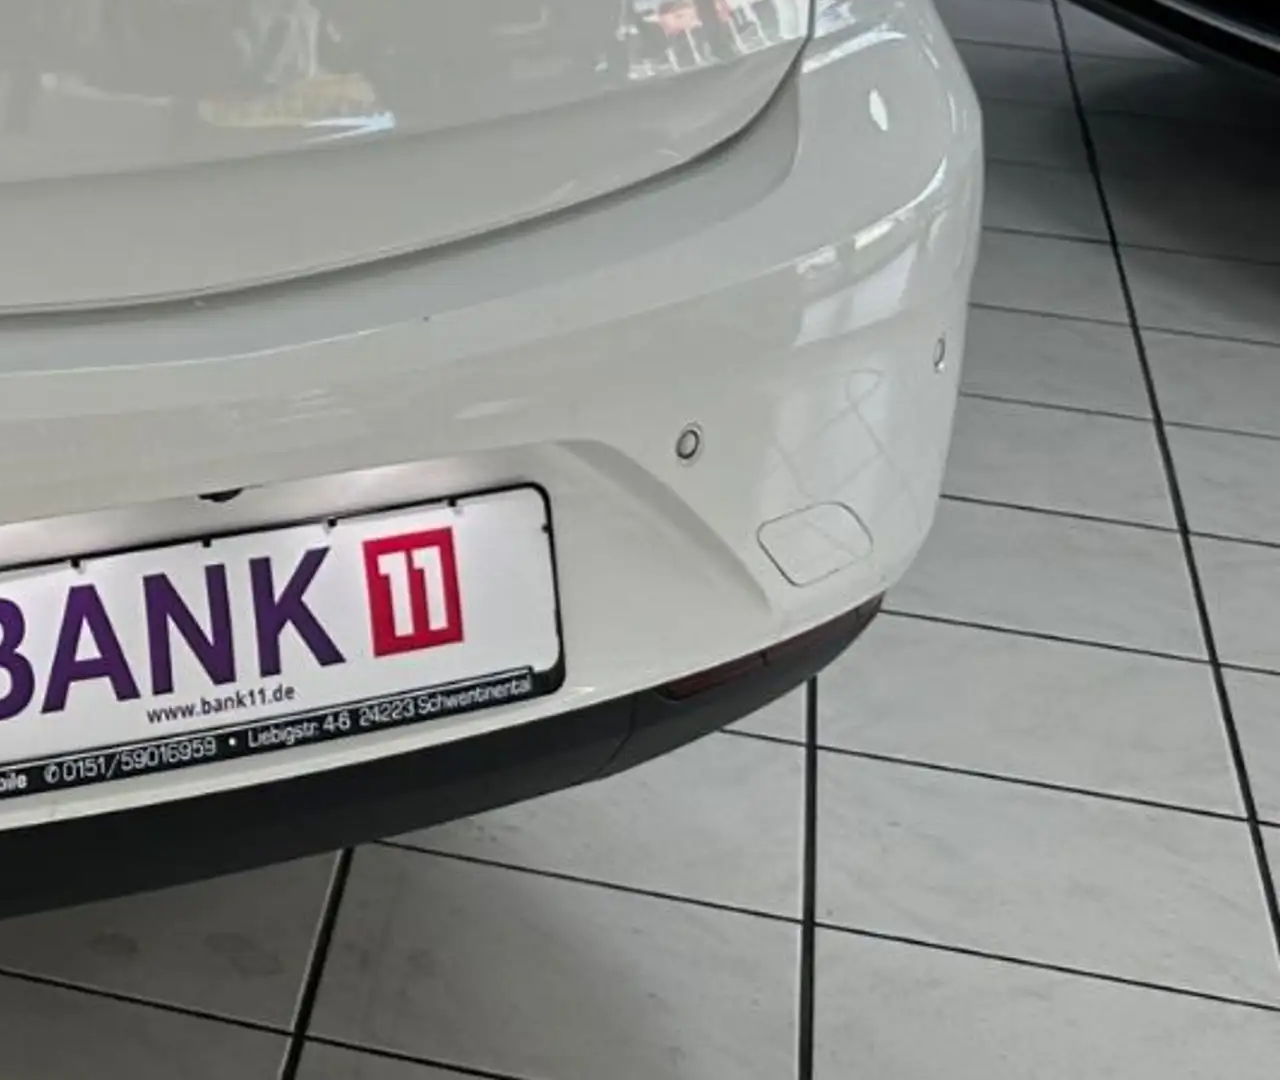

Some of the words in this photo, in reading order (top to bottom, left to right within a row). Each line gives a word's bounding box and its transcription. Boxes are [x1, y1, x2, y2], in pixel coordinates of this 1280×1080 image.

[372, 541, 452, 644] 11
[146, 684, 296, 725] www.bank11.de
[358, 698, 415, 727] 24223
